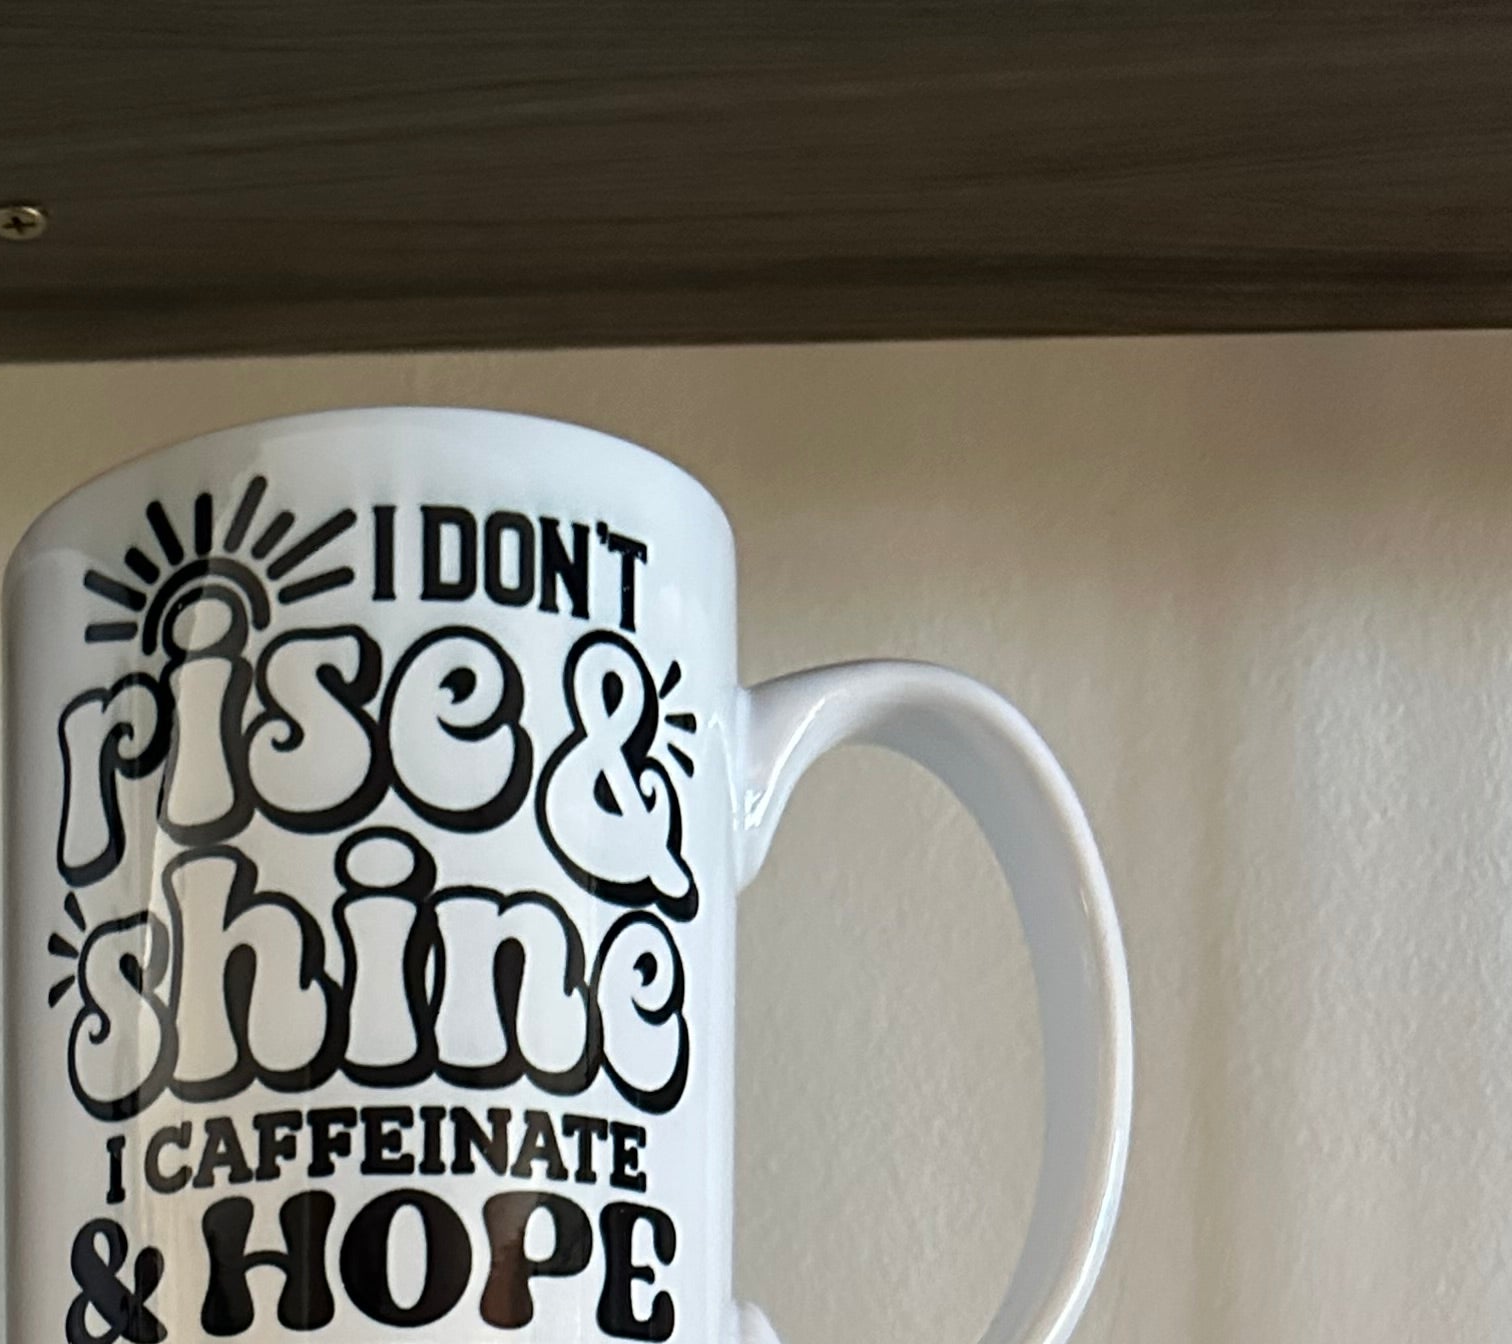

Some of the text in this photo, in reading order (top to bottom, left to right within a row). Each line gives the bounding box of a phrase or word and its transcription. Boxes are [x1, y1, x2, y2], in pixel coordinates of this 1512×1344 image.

[371, 504, 649, 633] I DON'T
[57, 582, 699, 922] rise &
[67, 826, 691, 1121] shine
[106, 1105, 649, 1204] I CAFFEINATE
[200, 1188, 678, 1343] HOPE
